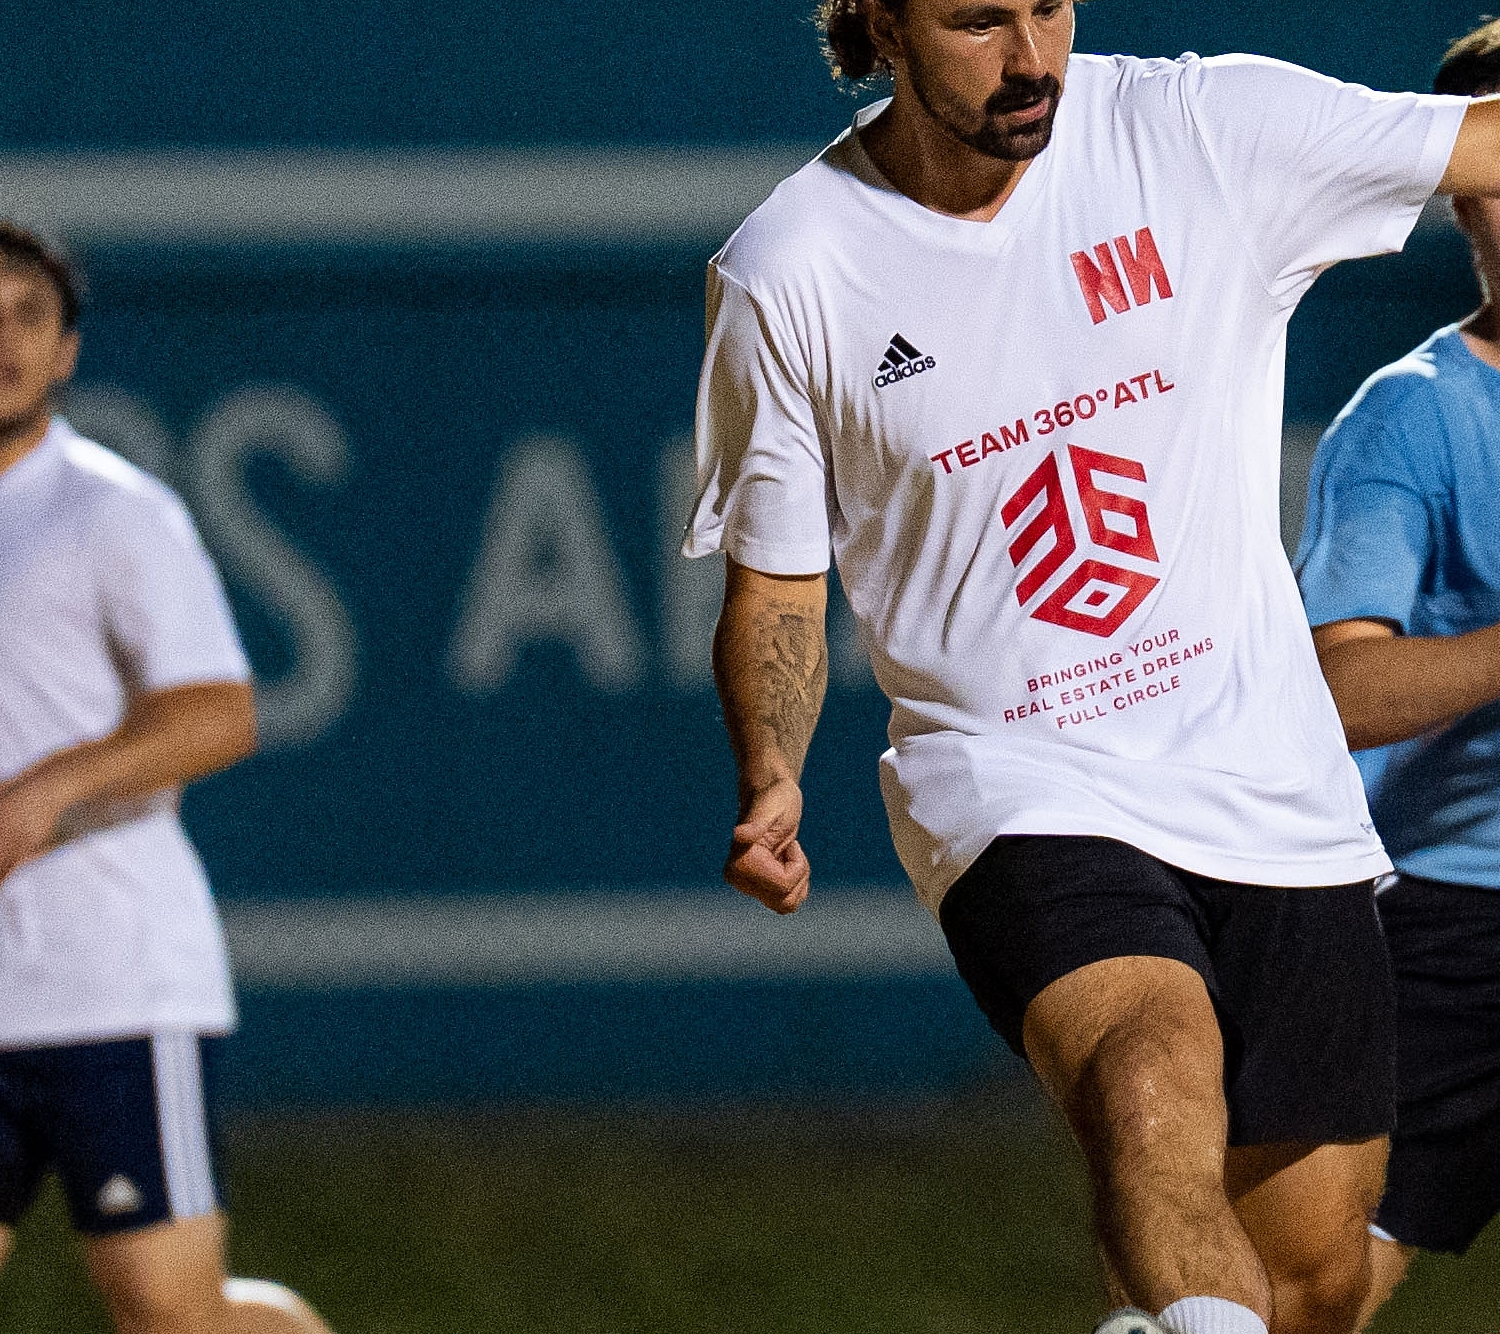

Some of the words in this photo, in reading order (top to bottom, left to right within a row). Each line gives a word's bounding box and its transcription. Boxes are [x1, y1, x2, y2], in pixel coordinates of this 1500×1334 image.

[874, 355, 937, 388] adidas
[930, 418, 1031, 475] TEAM
[1003, 697, 1055, 724] REAL
[1059, 668, 1138, 706] ESTATE
[1142, 636, 1215, 677] DREAMS
[1026, 651, 1124, 694] BRINGING
[1127, 628, 1182, 658] YOUR
[1055, 704, 1108, 730] FULL
[1112, 674, 1182, 712] CIRCLE
